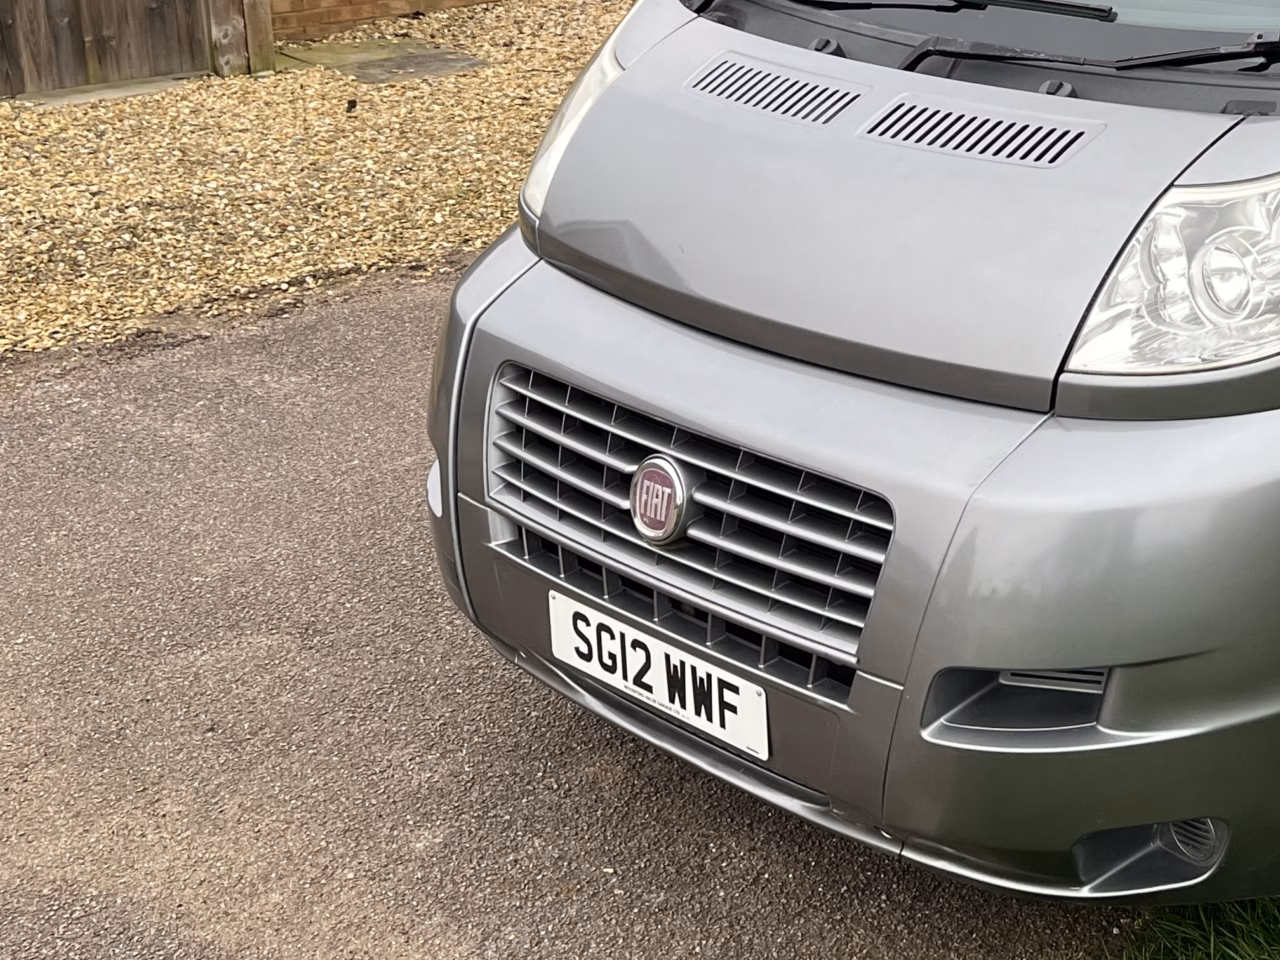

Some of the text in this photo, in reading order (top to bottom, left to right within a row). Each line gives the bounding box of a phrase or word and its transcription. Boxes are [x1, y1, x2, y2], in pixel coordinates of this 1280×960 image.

[640, 480, 672, 521] FIAT
[571, 611, 740, 730] SG12 WWF
